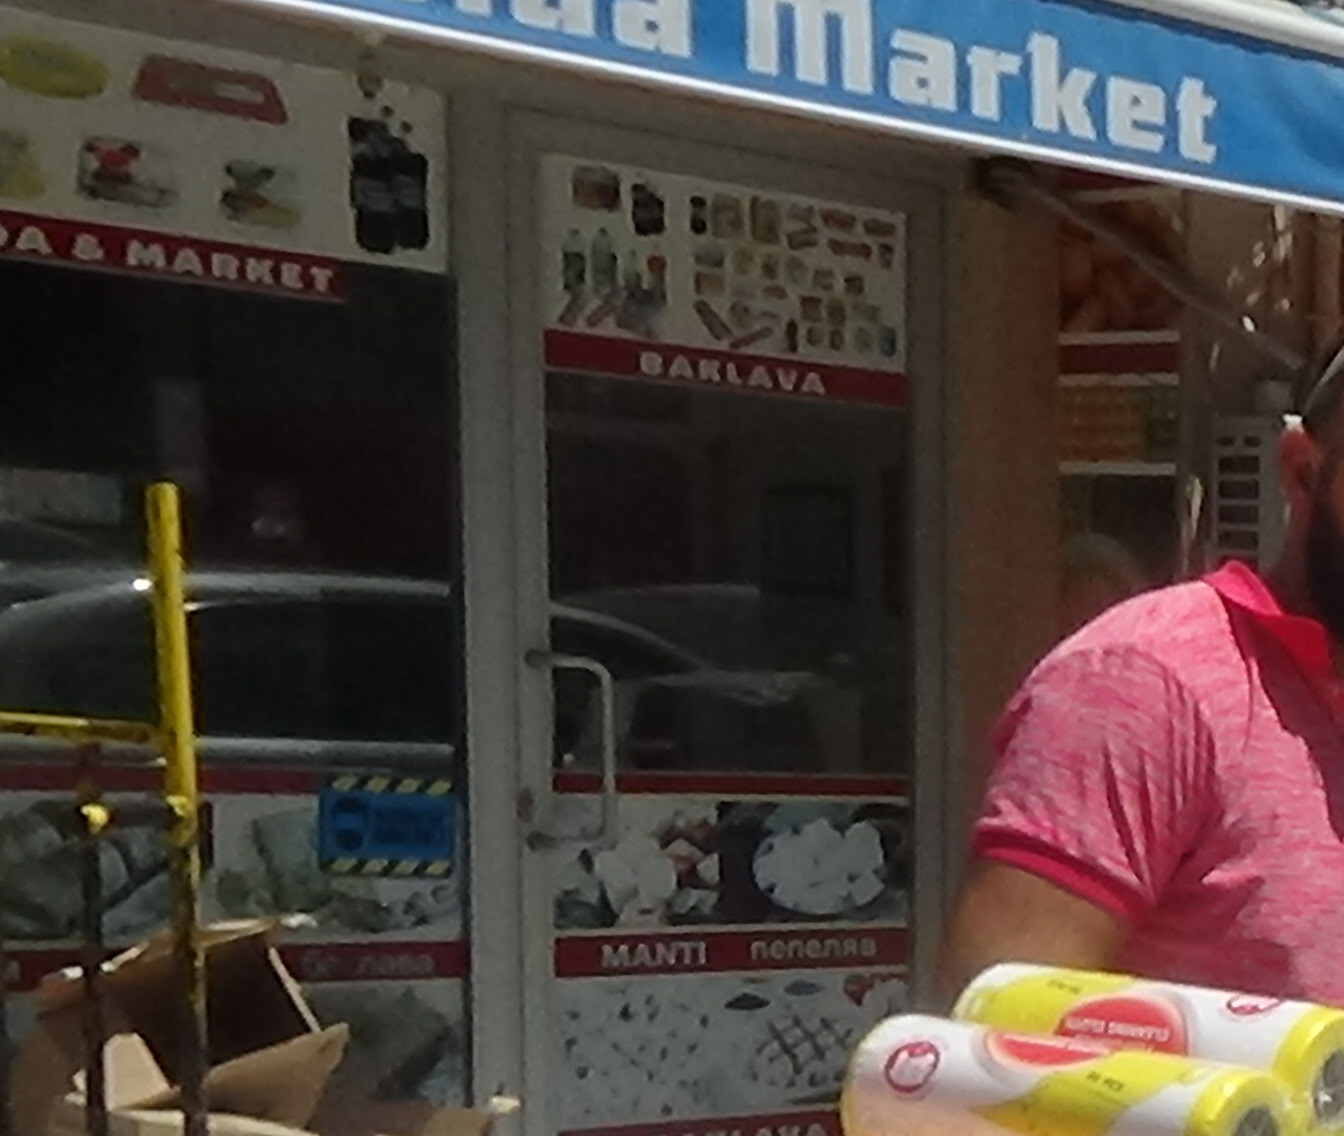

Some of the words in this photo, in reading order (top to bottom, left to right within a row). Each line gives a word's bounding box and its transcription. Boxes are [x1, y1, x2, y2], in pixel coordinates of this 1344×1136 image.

[745, 0, 1217, 163] Market
[71, 232, 104, 262] &
[126, 238, 335, 293] MARKET
[640, 350, 827, 396] BAKLAVA
[601, 941, 707, 968] MANTI
